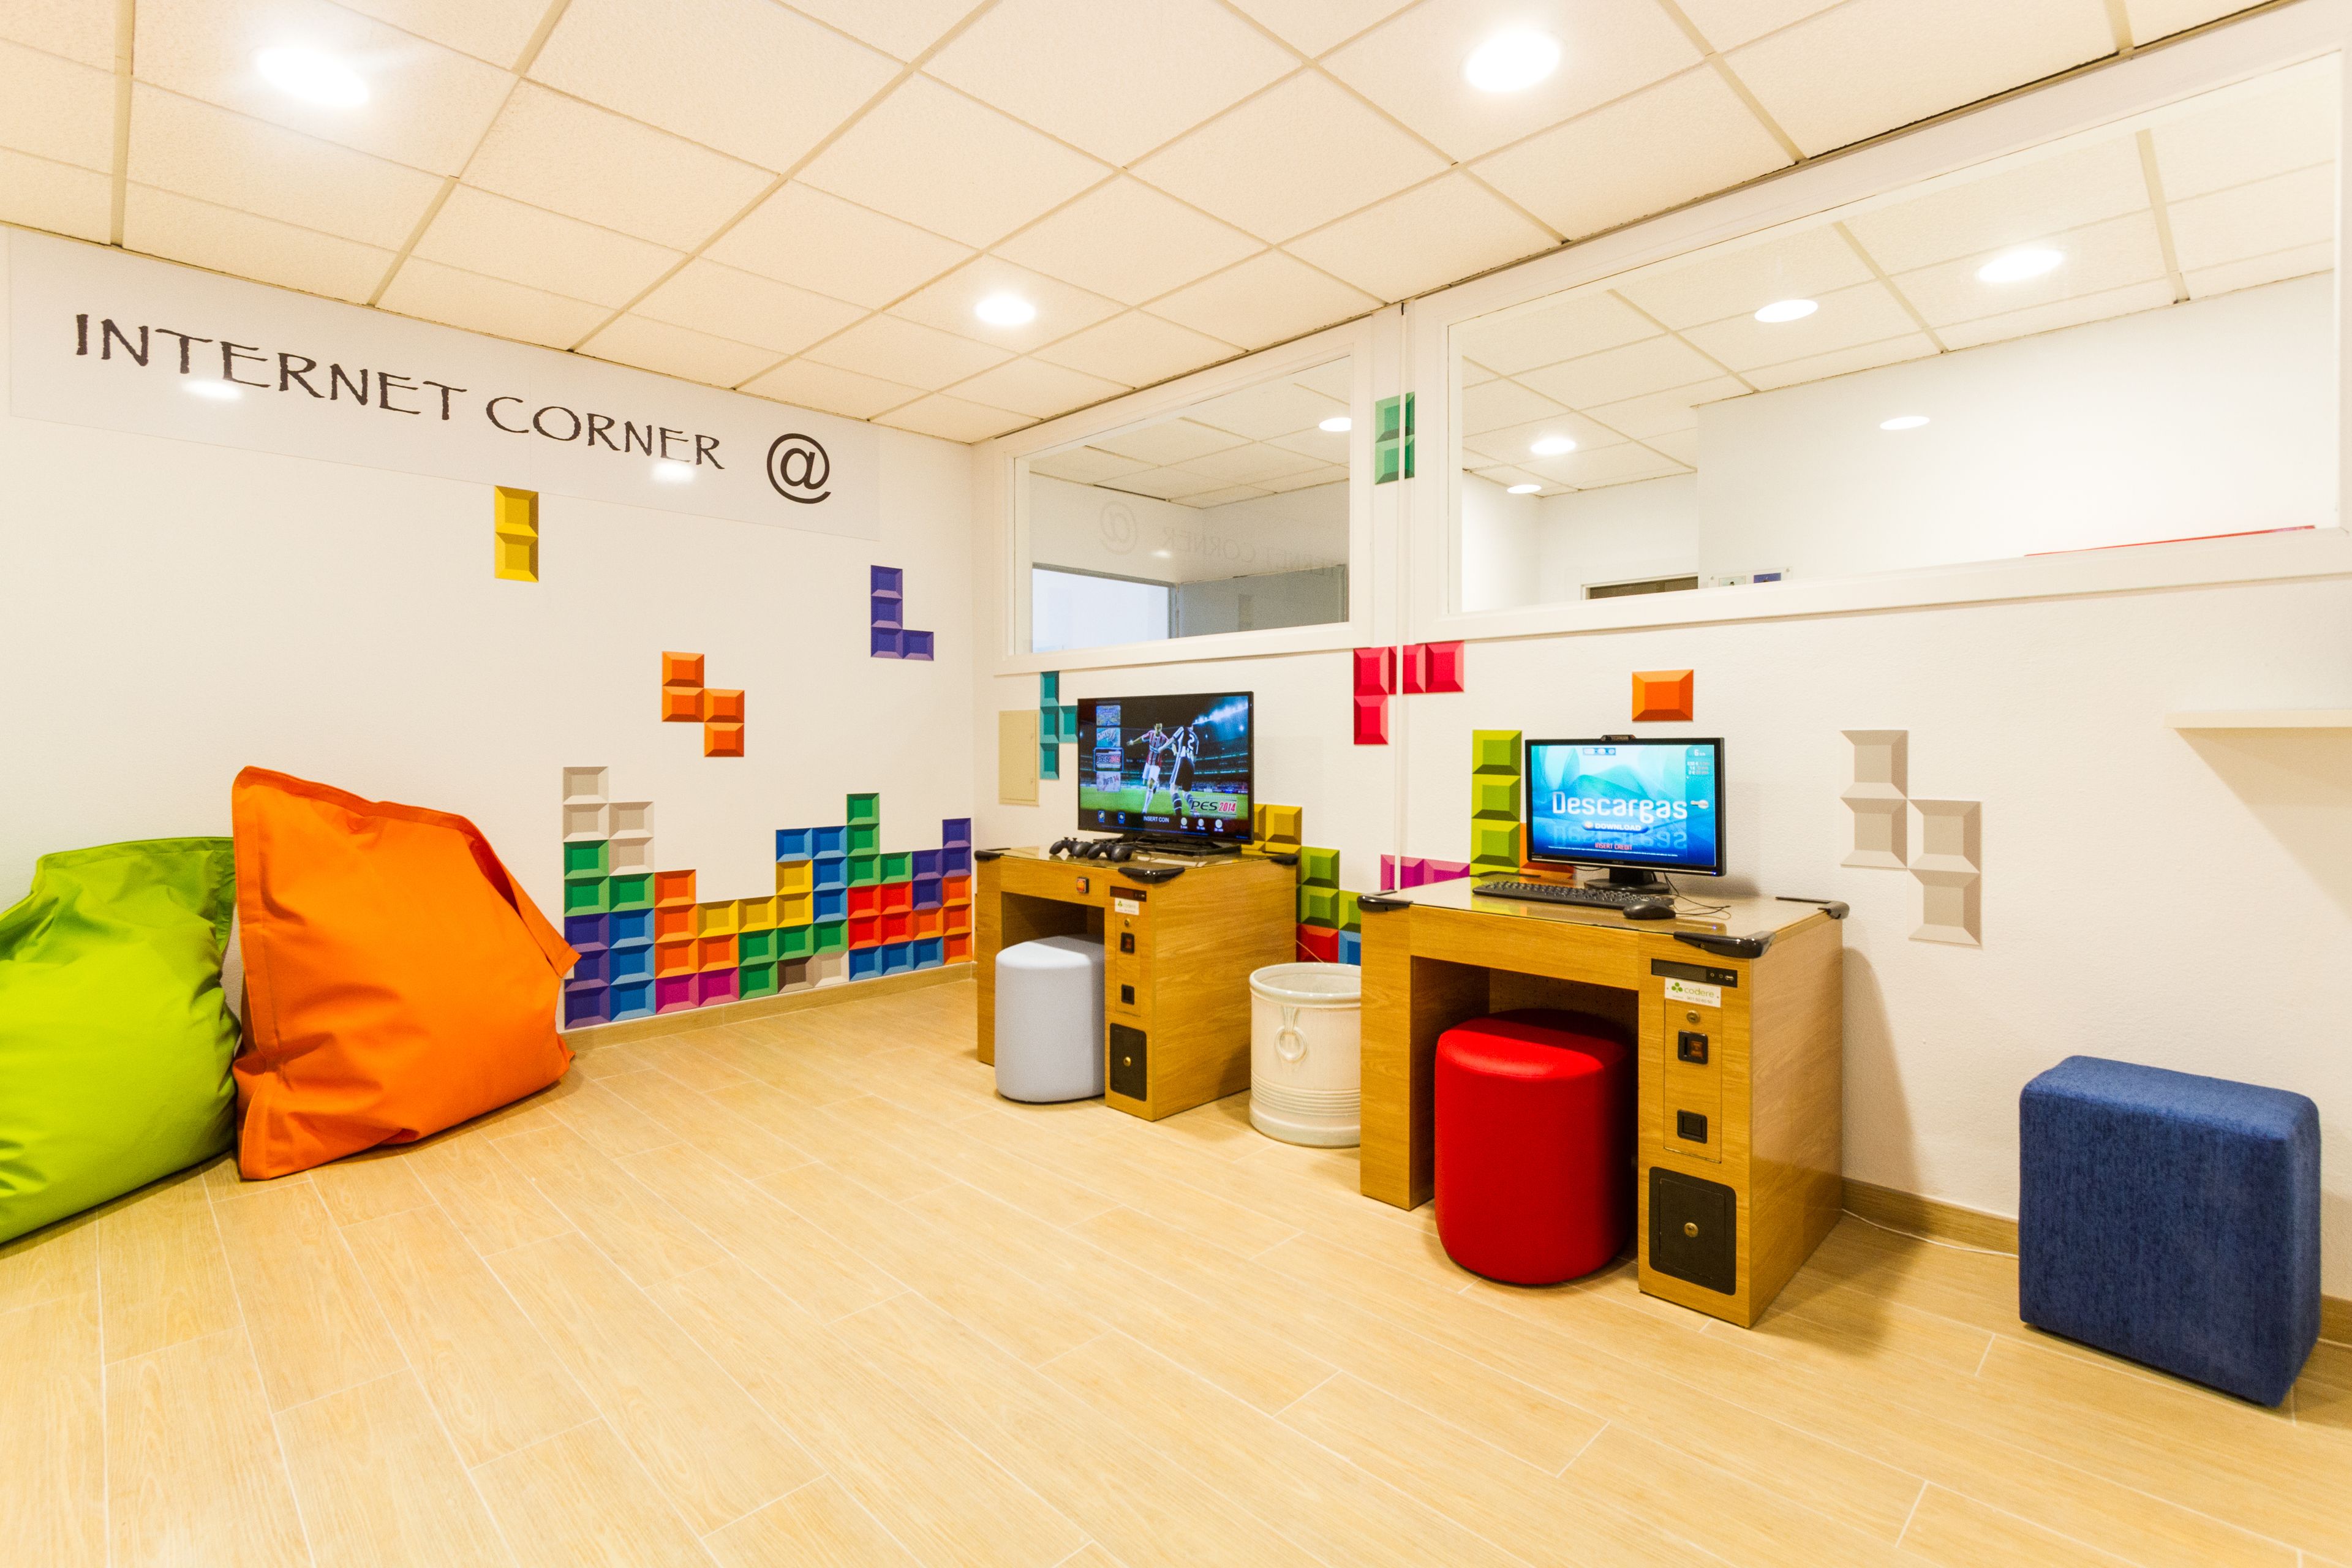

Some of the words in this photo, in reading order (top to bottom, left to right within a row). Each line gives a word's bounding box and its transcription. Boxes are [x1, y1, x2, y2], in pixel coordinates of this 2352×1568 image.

[76, 314, 467, 421] INTERNET
[486, 396, 725, 470] CORNER
[1190, 800, 1218, 811] PES
[1218, 801, 1237, 812] 2014
[1552, 791, 1688, 824] Descargas
[1594, 822, 1642, 832] DOWNLOAD
[1684, 987, 1714, 998] codere
